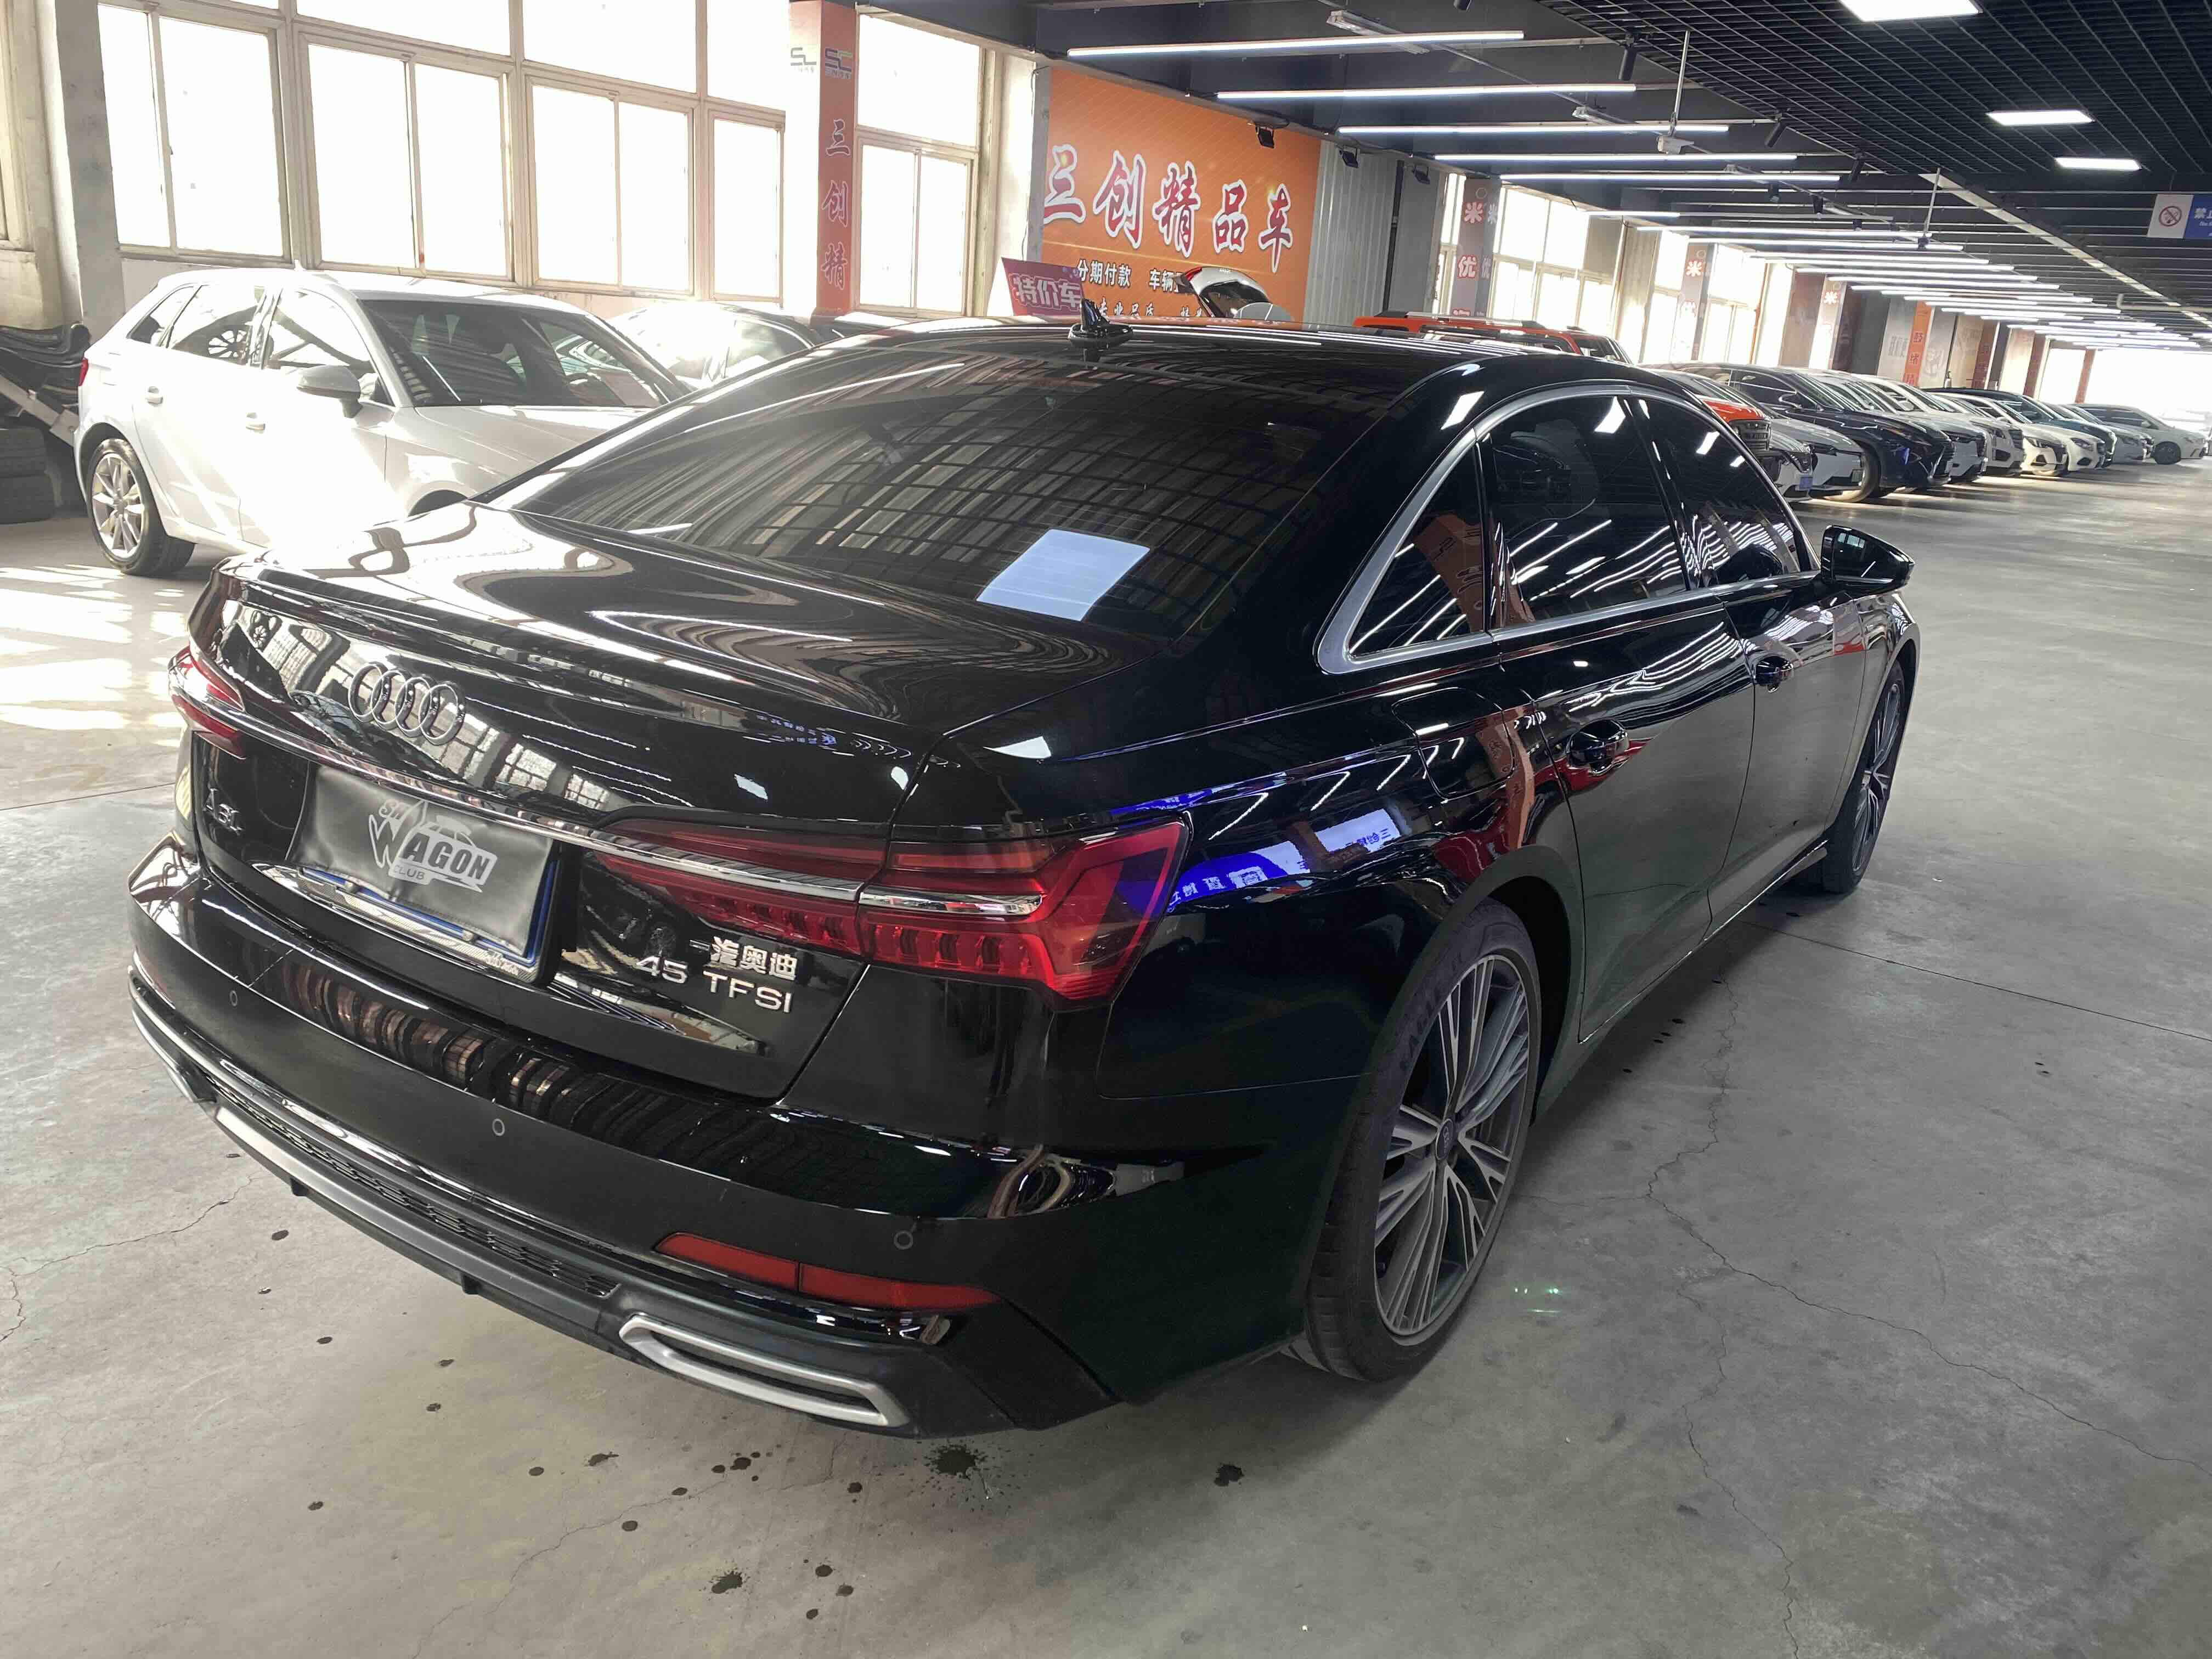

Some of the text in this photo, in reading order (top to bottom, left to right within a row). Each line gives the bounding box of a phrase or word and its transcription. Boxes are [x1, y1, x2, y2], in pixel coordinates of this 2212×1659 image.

[1043, 144, 1293, 273] 三创精品车
[1013, 276, 1082, 309] 特价车
[1077, 259, 1180, 293] 分期付款 车辆
[394, 864, 425, 880] CLUB
[636, 956, 792, 1013] 45 TFSI
